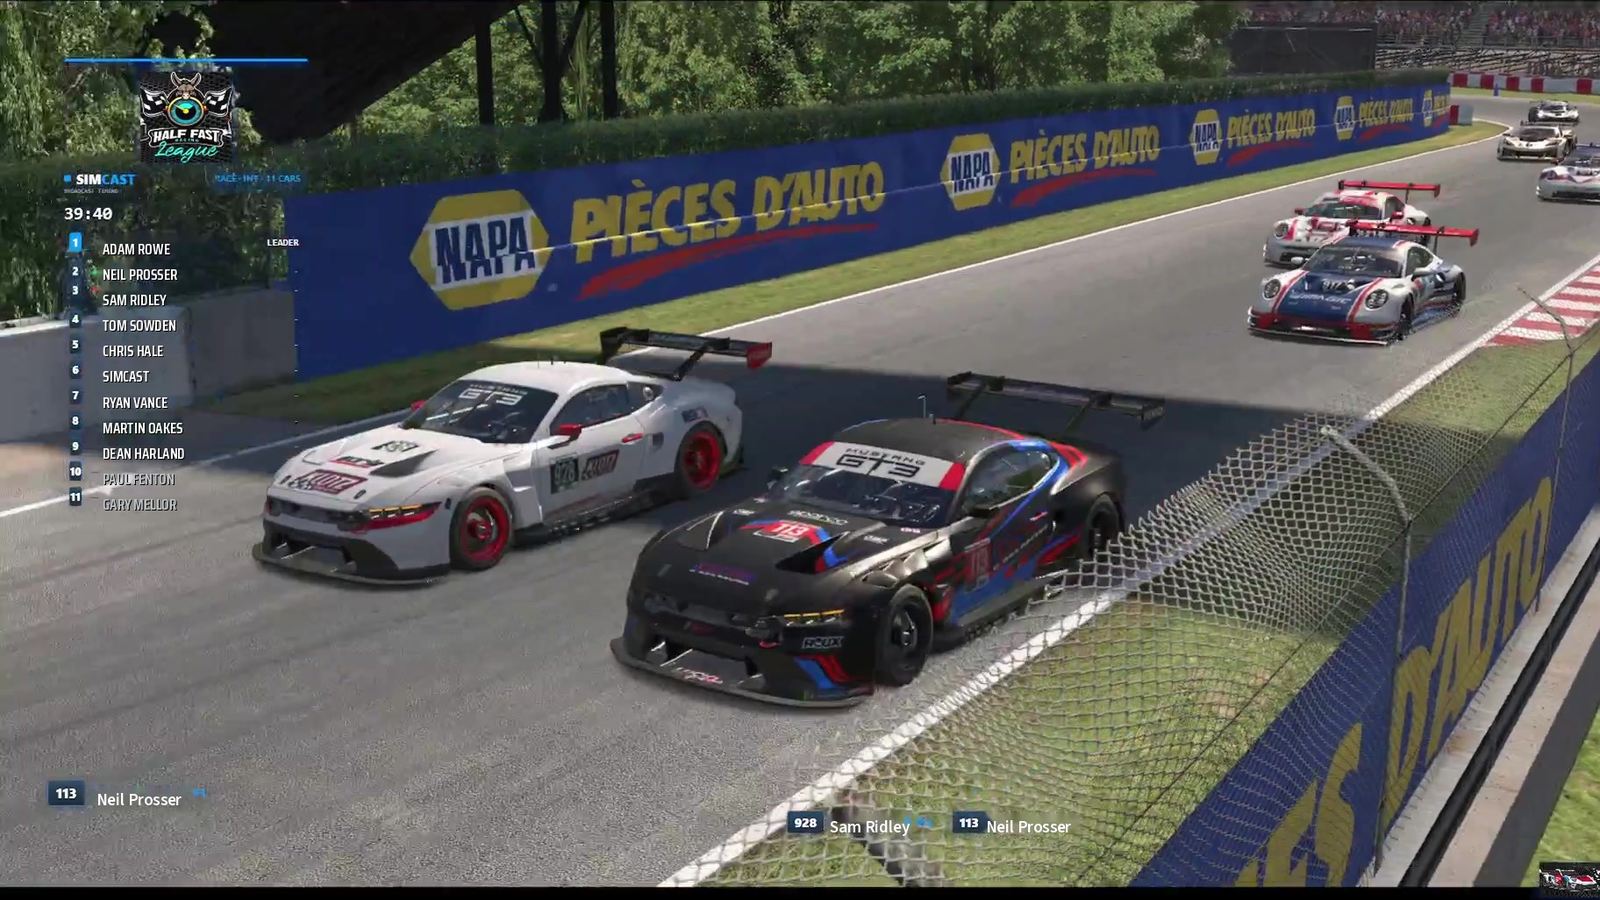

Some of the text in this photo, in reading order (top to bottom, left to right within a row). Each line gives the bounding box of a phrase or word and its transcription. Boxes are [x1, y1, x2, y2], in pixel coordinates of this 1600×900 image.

[951, 125, 1160, 193] NAPA PIÈCES D'AUTO
[435, 161, 885, 284] NAPA PIÈCES D'AUTO
[458, 387, 523, 406] GT3
[836, 454, 920, 478] GT3
[770, 522, 810, 538] 113
